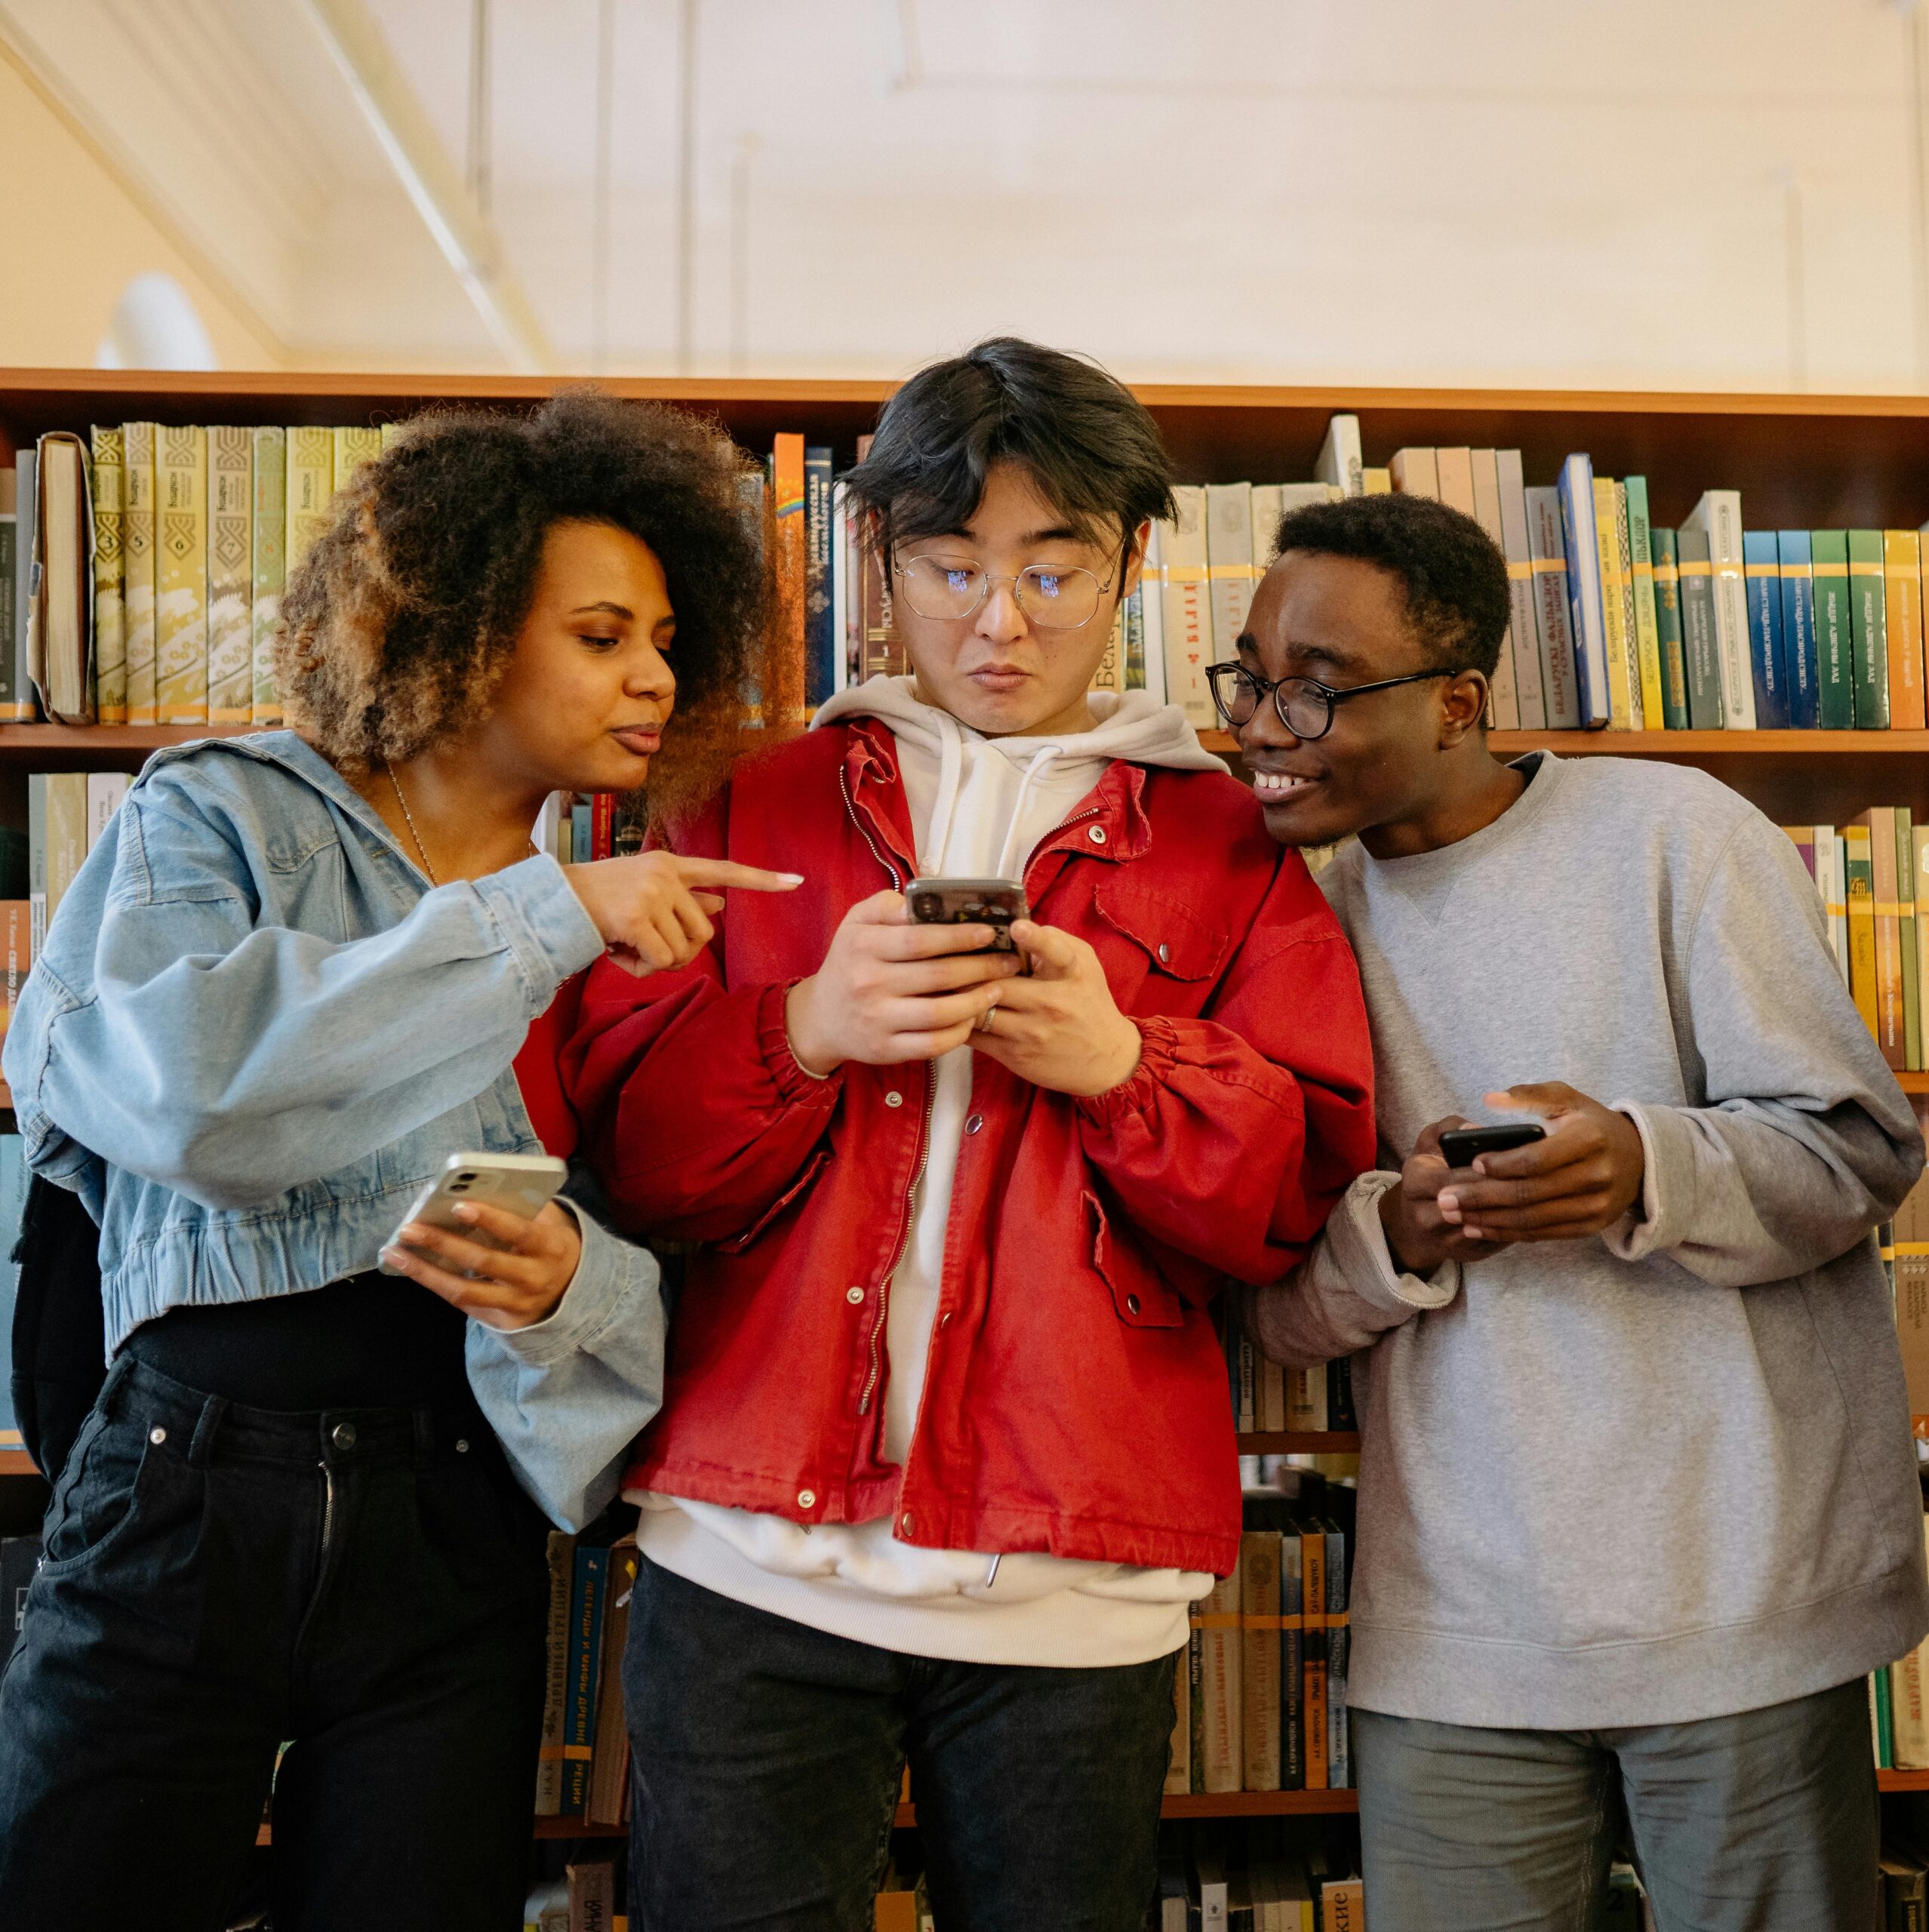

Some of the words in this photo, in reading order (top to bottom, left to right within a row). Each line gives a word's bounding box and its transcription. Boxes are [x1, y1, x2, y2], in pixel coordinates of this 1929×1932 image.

[103, 535, 114, 550] 3
[134, 534, 143, 549] 5
[174, 538, 183, 551] 6
[226, 542, 235, 554] 7
[1644, 636, 1655, 684] БЕЛАРУСКІ
[555, 1578, 566, 1636] ГРЕЦИИ
[582, 1580, 594, 1636] ЛЕГЕНДЫ
[553, 1641, 564, 1707] ДРЕВНЕЙ
[579, 1654, 590, 1692] МИФЫ
[575, 1697, 586, 1743] ДРЕВНЕ
[572, 1764, 583, 1804] РЕЦИИ
